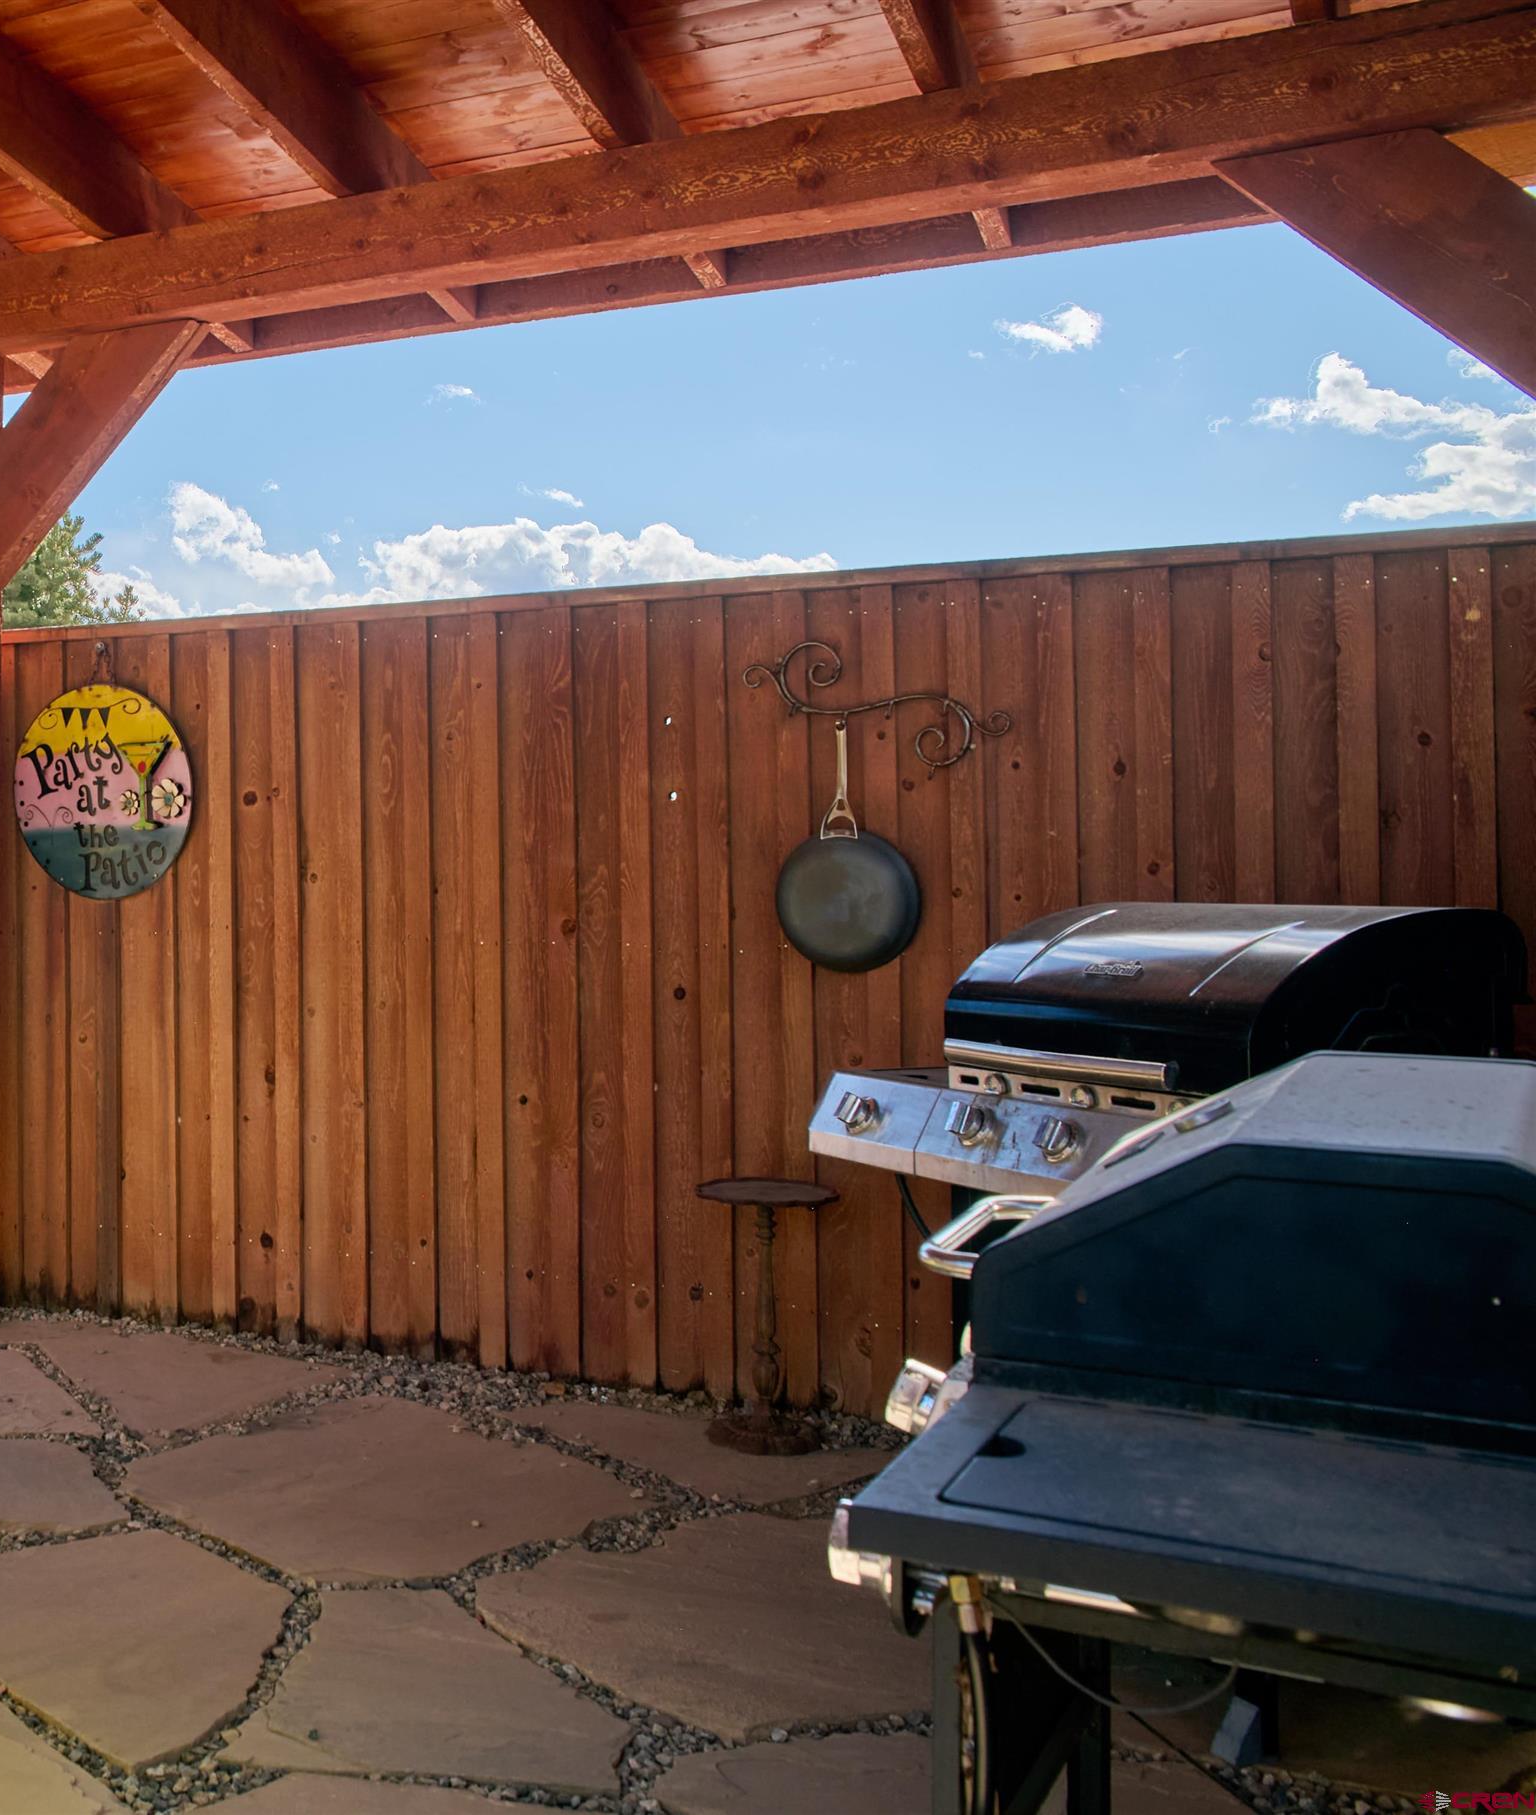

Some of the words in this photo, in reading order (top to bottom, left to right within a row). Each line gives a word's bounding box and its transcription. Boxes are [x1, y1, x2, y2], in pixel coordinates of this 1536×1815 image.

[21, 732, 123, 800] Party
[76, 776, 110, 816] at
[73, 821, 119, 848] the
[79, 840, 167, 892] Patio
